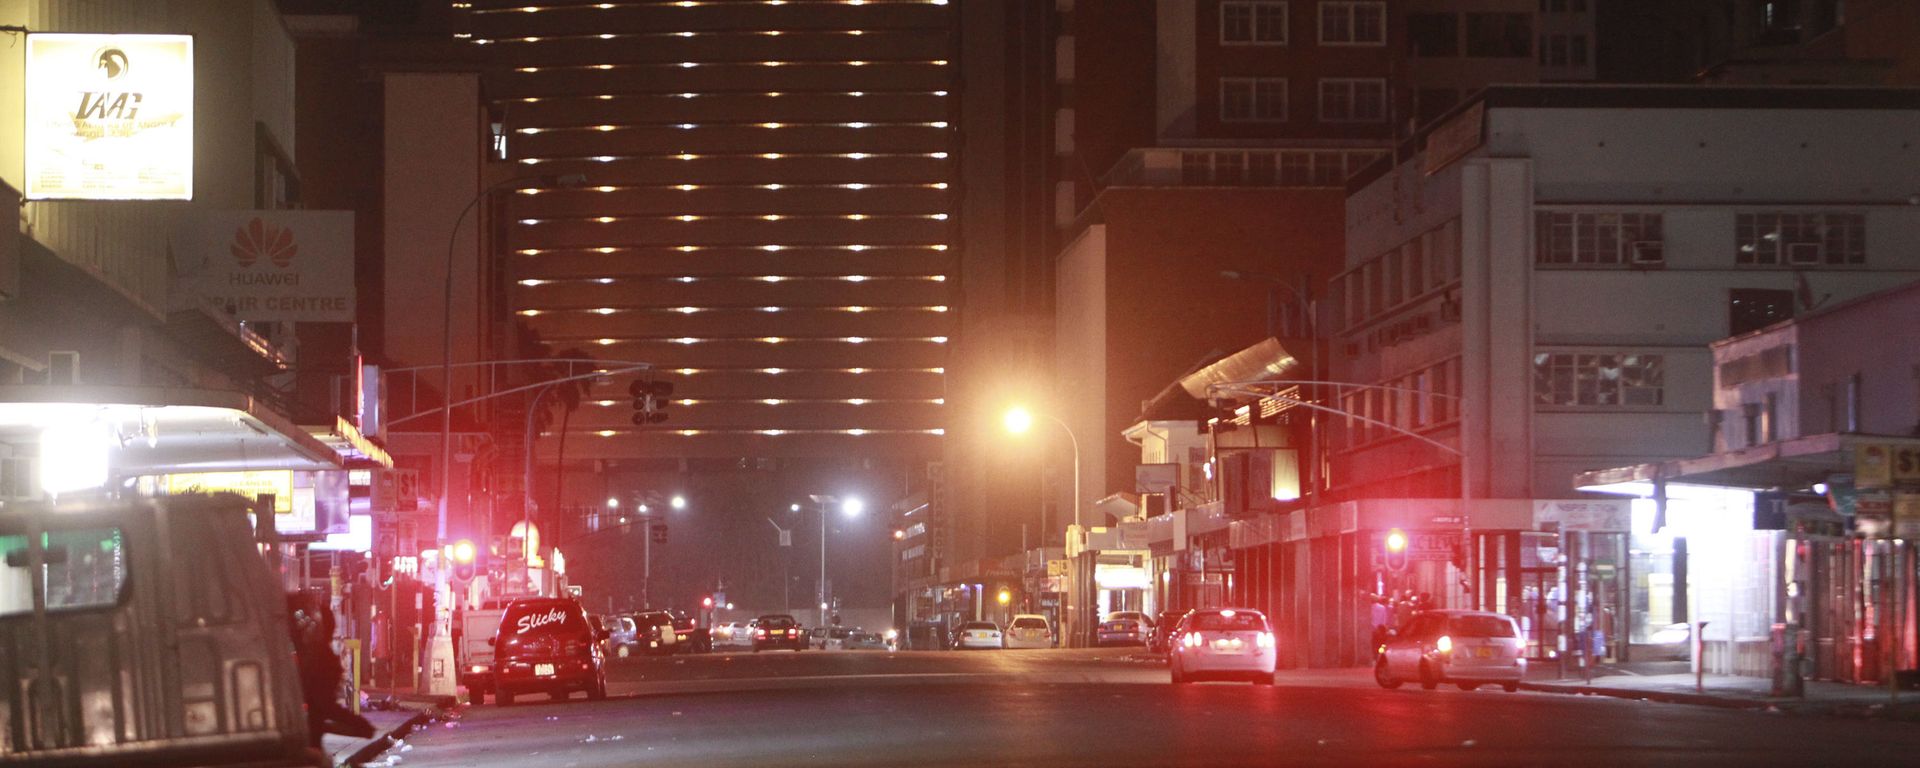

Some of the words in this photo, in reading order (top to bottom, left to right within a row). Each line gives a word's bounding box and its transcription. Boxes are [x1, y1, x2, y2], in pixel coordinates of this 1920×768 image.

[76, 92, 143, 119] TAAG
[229, 272, 300, 286] HUAWEI
[266, 297, 346, 311] CENTRE
[516, 607, 567, 634] Slicky
